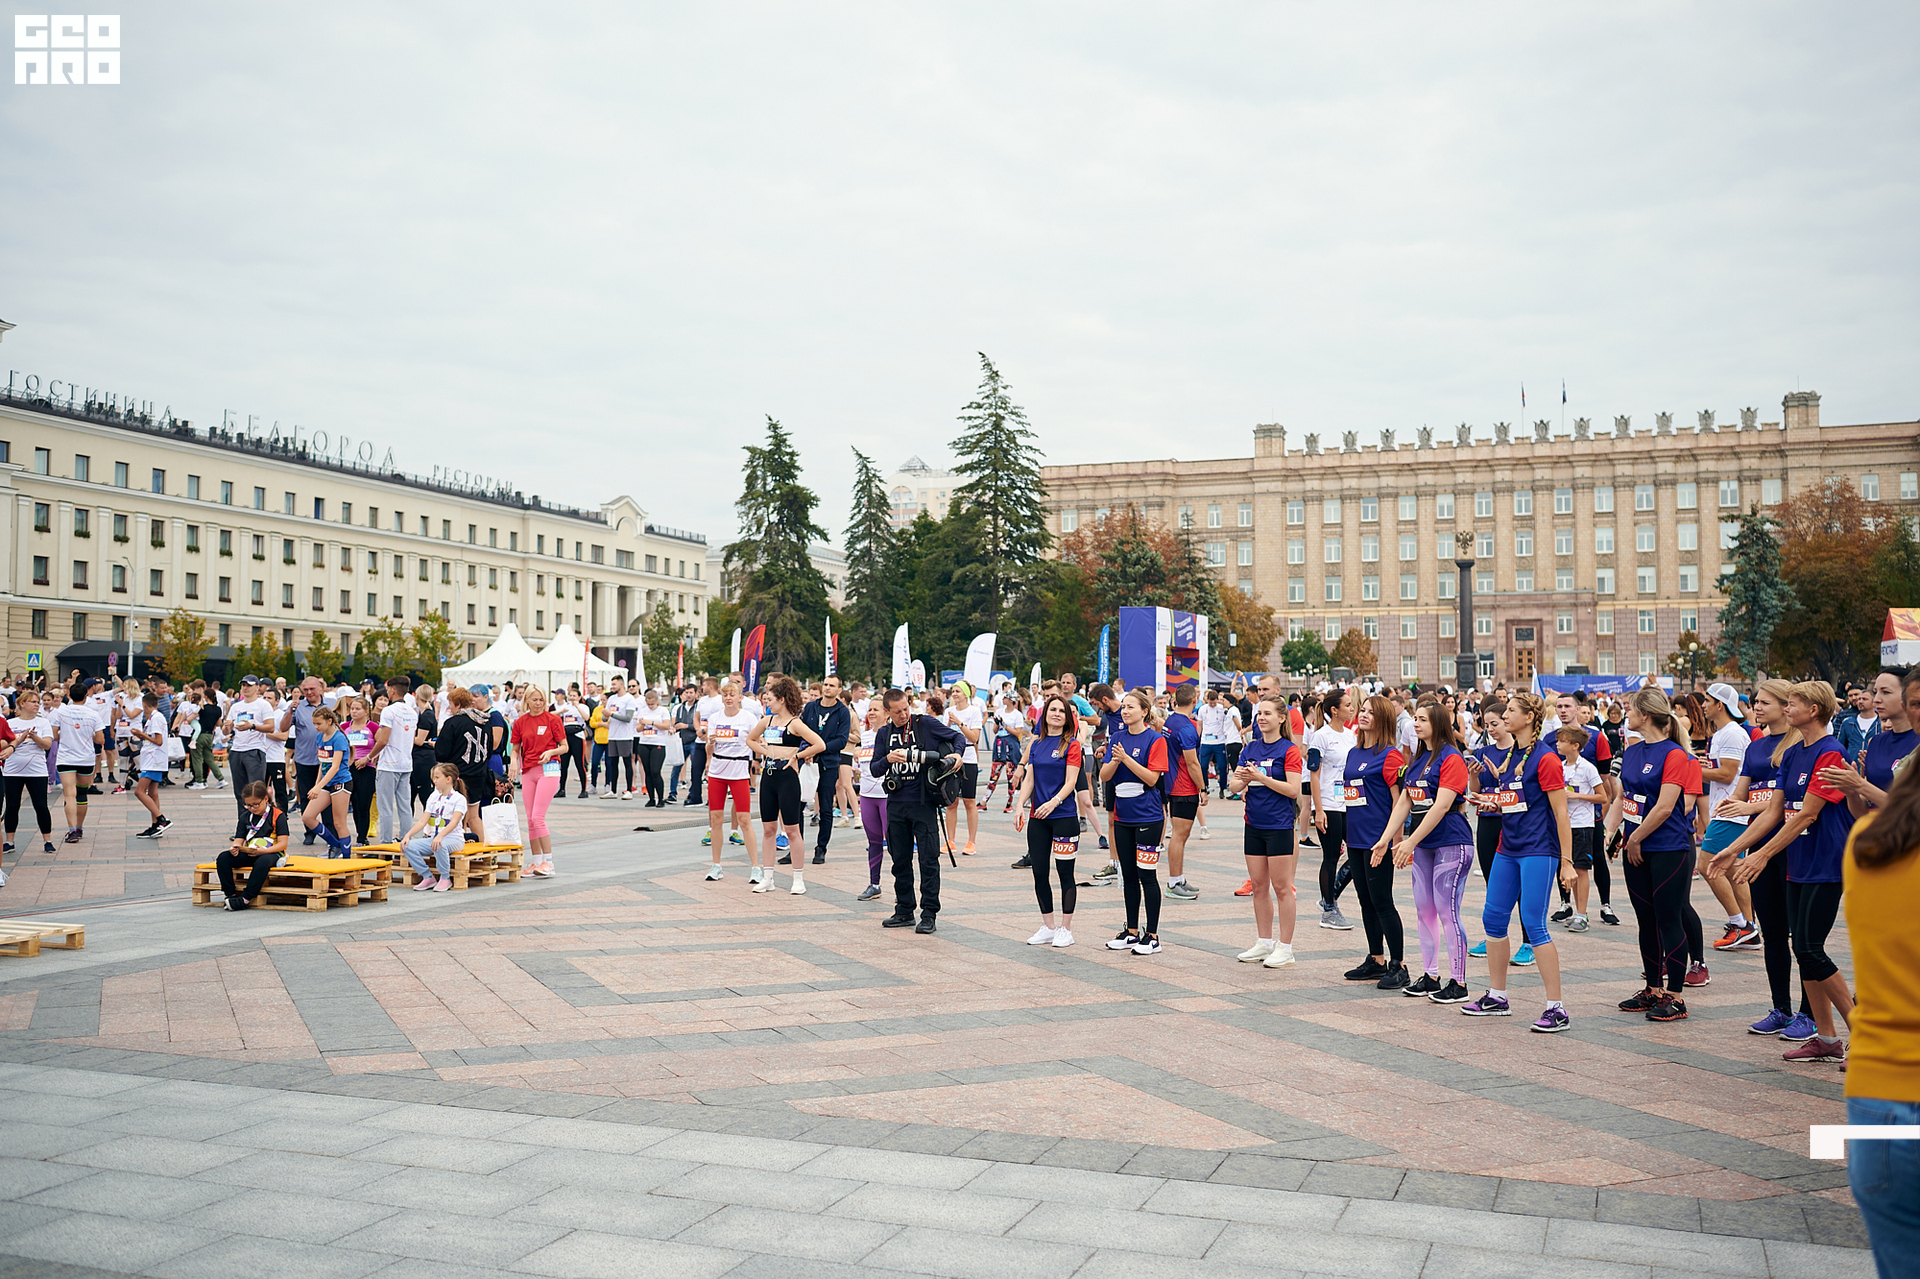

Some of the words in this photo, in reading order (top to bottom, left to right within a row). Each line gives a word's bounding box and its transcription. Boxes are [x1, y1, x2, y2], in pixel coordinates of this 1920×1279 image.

[8, 369, 174, 429] ГОСТИНИЦА
[222, 408, 398, 470] БЕЛГОРОД
[433, 464, 514, 494] РЕСТОРАН
[717, 729, 733, 737] 5241
[891, 762, 920, 774] NOW
[1751, 790, 1773, 803] 5309
[1053, 843, 1075, 853] 5076
[1137, 852, 1158, 862] 5275
